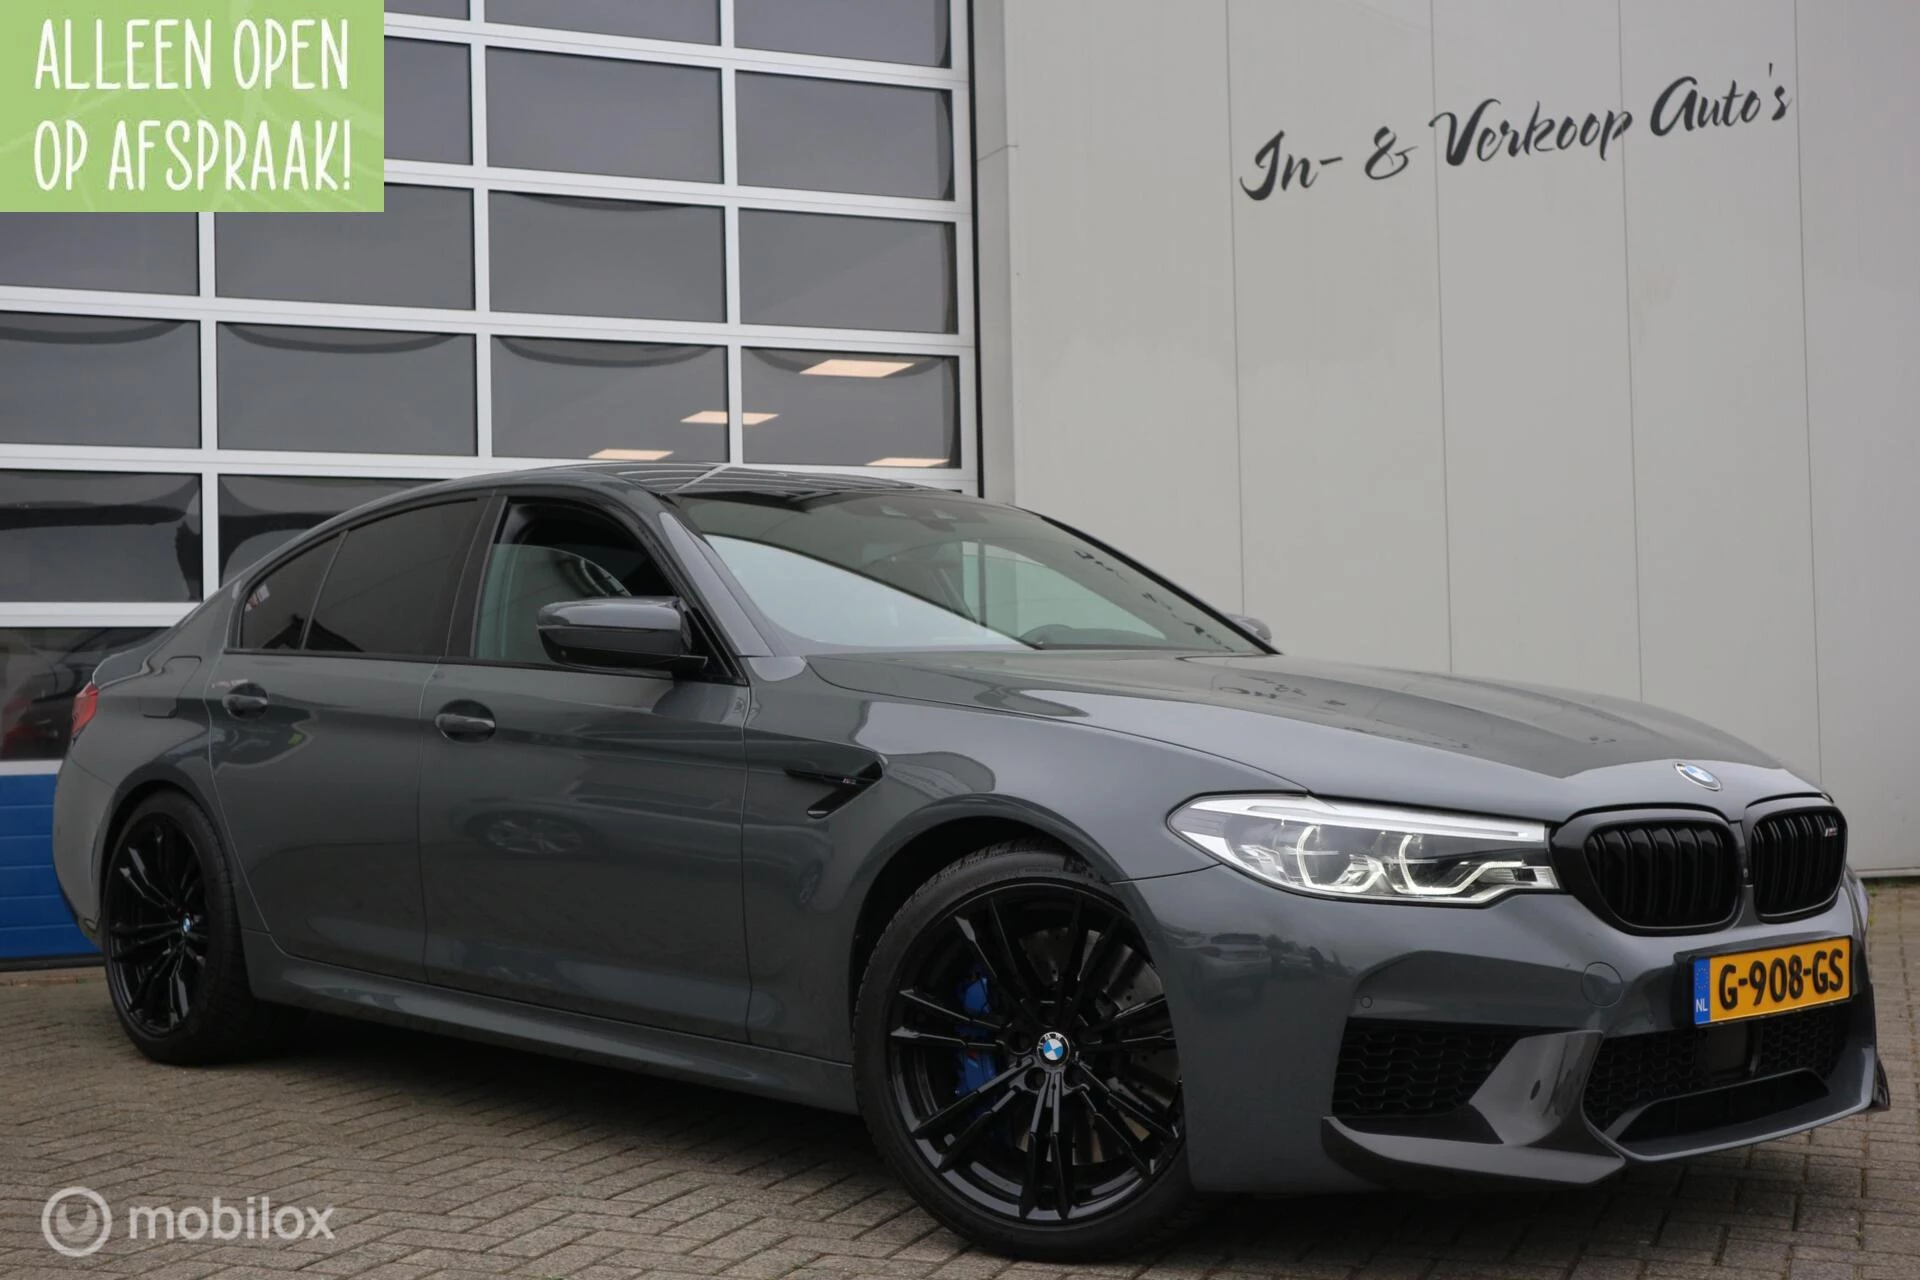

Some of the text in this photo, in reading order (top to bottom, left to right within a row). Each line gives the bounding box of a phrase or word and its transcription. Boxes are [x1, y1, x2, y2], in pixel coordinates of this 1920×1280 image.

[1239, 62, 1791, 200] In- & Verkoop Auto's
[1695, 998, 1709, 1012] NL
[1719, 949, 1843, 1010] G-908-GS
